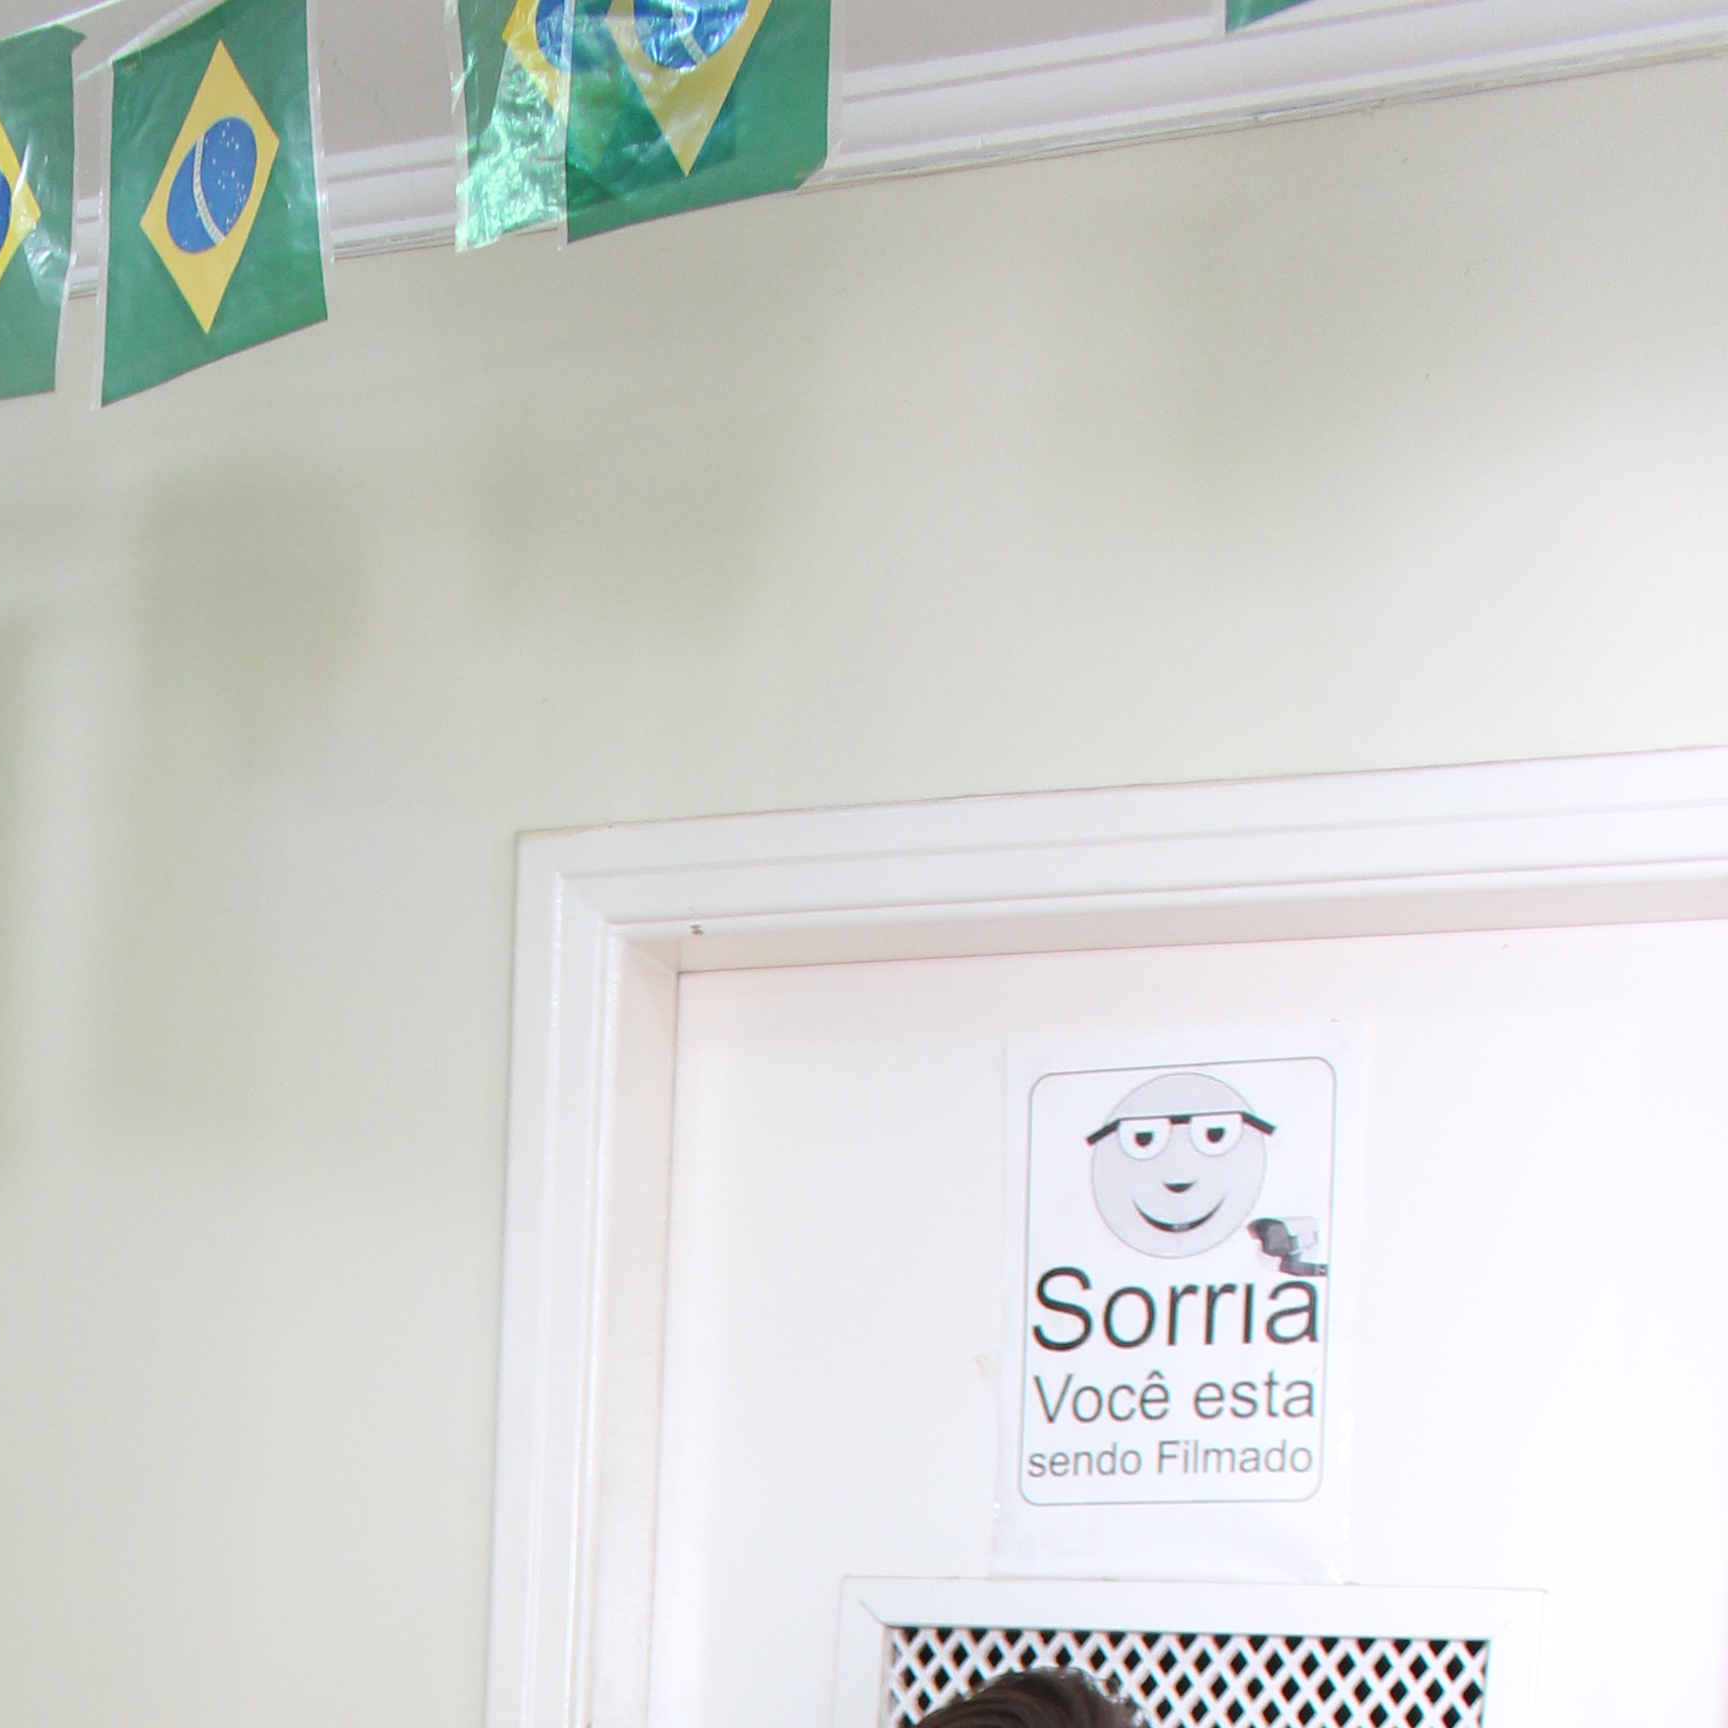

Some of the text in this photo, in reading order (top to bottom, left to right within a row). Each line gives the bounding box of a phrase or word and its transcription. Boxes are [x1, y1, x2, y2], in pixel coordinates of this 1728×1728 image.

[1032, 1266, 1320, 1352] Sorria
[1034, 1369, 1316, 1424] Você esta
[1027, 1439, 1314, 1478] sendo Filmado
